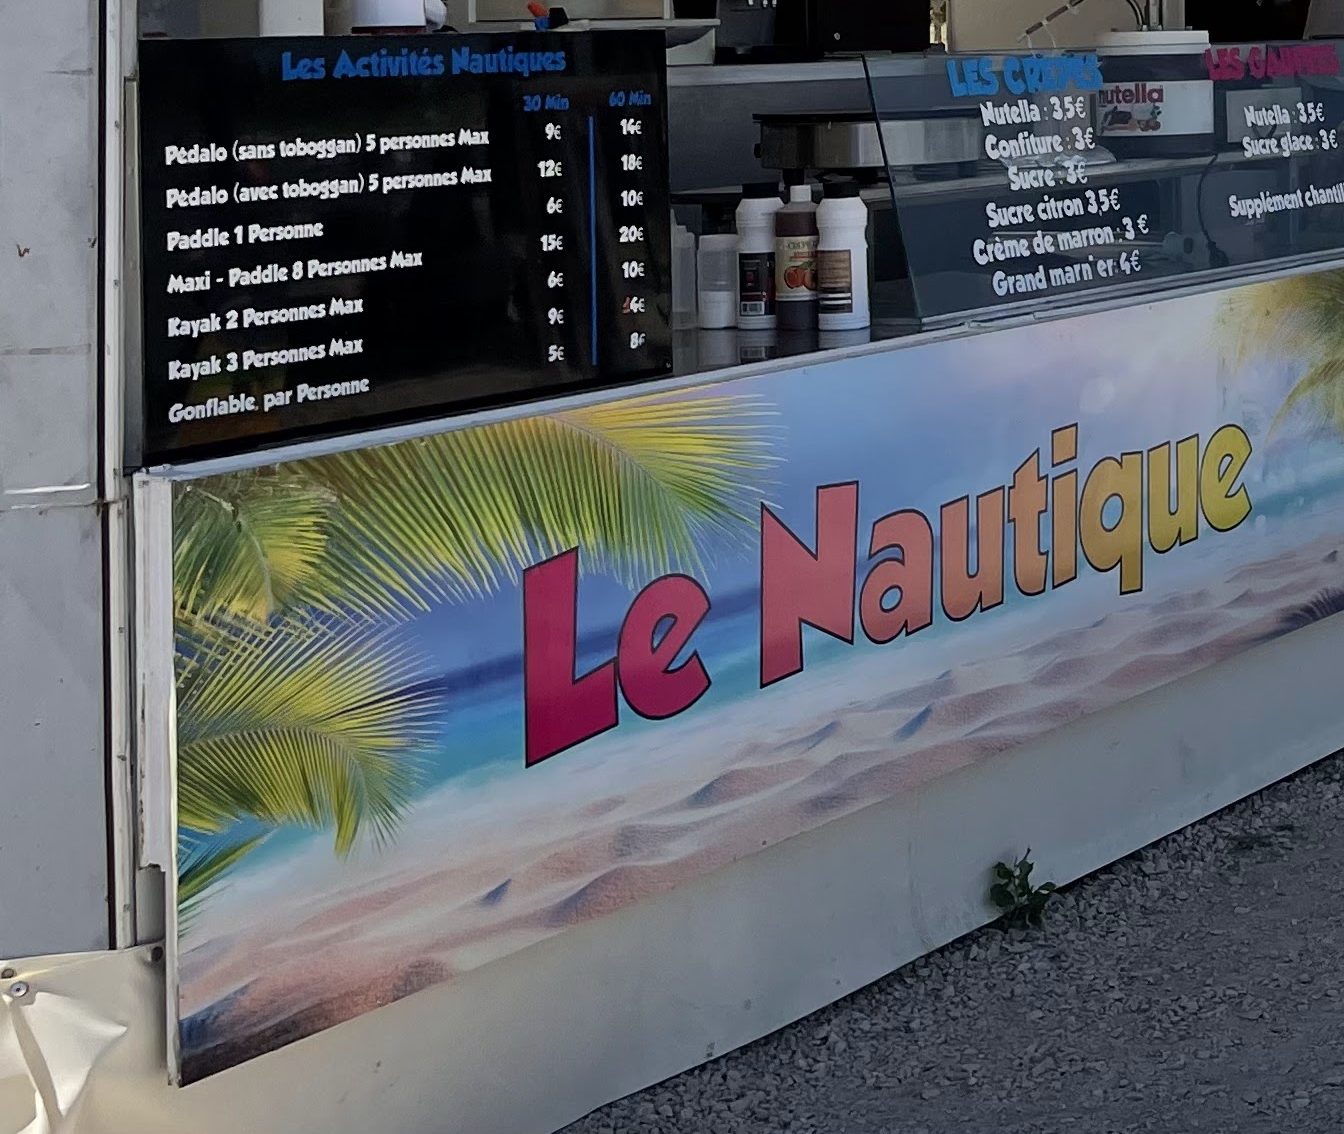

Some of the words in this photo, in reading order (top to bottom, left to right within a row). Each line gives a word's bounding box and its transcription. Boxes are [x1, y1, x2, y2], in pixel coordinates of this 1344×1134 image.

[281, 52, 325, 80] Les
[333, 47, 445, 78] Activités
[451, 45, 567, 77] Nautiques
[947, 56, 999, 97] LES
[1205, 47, 1245, 81] LES
[523, 95, 542, 112] 30
[545, 94, 570, 111] Min
[609, 90, 626, 107] 60
[629, 89, 652, 105] Min
[1098, 83, 1164, 104] nutella
[980, 99, 1041, 126] Nutella
[1050, 95, 1086, 122] 3,5€
[1244, 105, 1290, 127] Nutella
[1296, 102, 1325, 124] 3,5€
[545, 122, 562, 140] 9€
[620, 118, 642, 136] 14€
[165, 143, 228, 166] Pédalo
[232, 139, 276, 162] (sans
[279, 132, 362, 160] toboggan)
[365, 133, 376, 152] 5
[379, 131, 456, 154] personnes
[458, 128, 490, 146] Max
[985, 131, 1063, 160] Confiture
[1072, 126, 1096, 150] 3€
[1242, 136, 1279, 158] Sucre
[1280, 132, 1314, 158] glace
[1319, 129, 1338, 150] 3€
[538, 159, 563, 178] 12€
[620, 154, 643, 171] 18€
[1008, 165, 1056, 191] Sucre
[1065, 160, 1087, 184] 3€
[165, 185, 229, 209] Pédalo
[233, 181, 279, 204] (avec
[282, 172, 365, 200] toboggan)
[368, 173, 379, 192] 5
[382, 169, 459, 194] personnes
[460, 166, 492, 185] Max
[620, 189, 643, 208] 10€
[546, 196, 563, 214] 6€
[986, 202, 1035, 228] Sucre
[1037, 195, 1084, 220] citron
[1085, 188, 1121, 216] 3,5€
[1229, 190, 1304, 219] Supplément
[167, 228, 230, 251] Paddle
[234, 225, 244, 245] 1
[248, 222, 324, 243] Personne
[540, 234, 564, 252] 15€
[619, 225, 644, 243] 20€
[973, 237, 1030, 265] Crème
[1033, 230, 1055, 255] de
[1056, 224, 1115, 251] marron
[167, 270, 211, 294] Maxi
[228, 264, 288, 287] Paddle
[292, 261, 303, 280] 8
[307, 255, 387, 279] Personnes
[390, 250, 423, 269] Max
[547, 270, 564, 288] 6€
[622, 260, 645, 279] 10€
[992, 266, 1048, 296] Grand
[1119, 249, 1142, 275] 4€
[167, 313, 221, 338] Kayak
[225, 310, 239, 330] 2
[243, 303, 326, 328] Personnes
[329, 297, 364, 317] Max
[547, 307, 564, 325] 9€
[167, 355, 222, 381] Kayak
[226, 353, 238, 372] 3
[243, 344, 326, 370] Personnes
[329, 338, 364, 357] Max
[548, 345, 565, 362] 5€
[263, 389, 293, 412] par
[297, 378, 370, 403] Personne
[523, 545, 712, 768] Le
[760, 422, 1253, 689] Nautique
